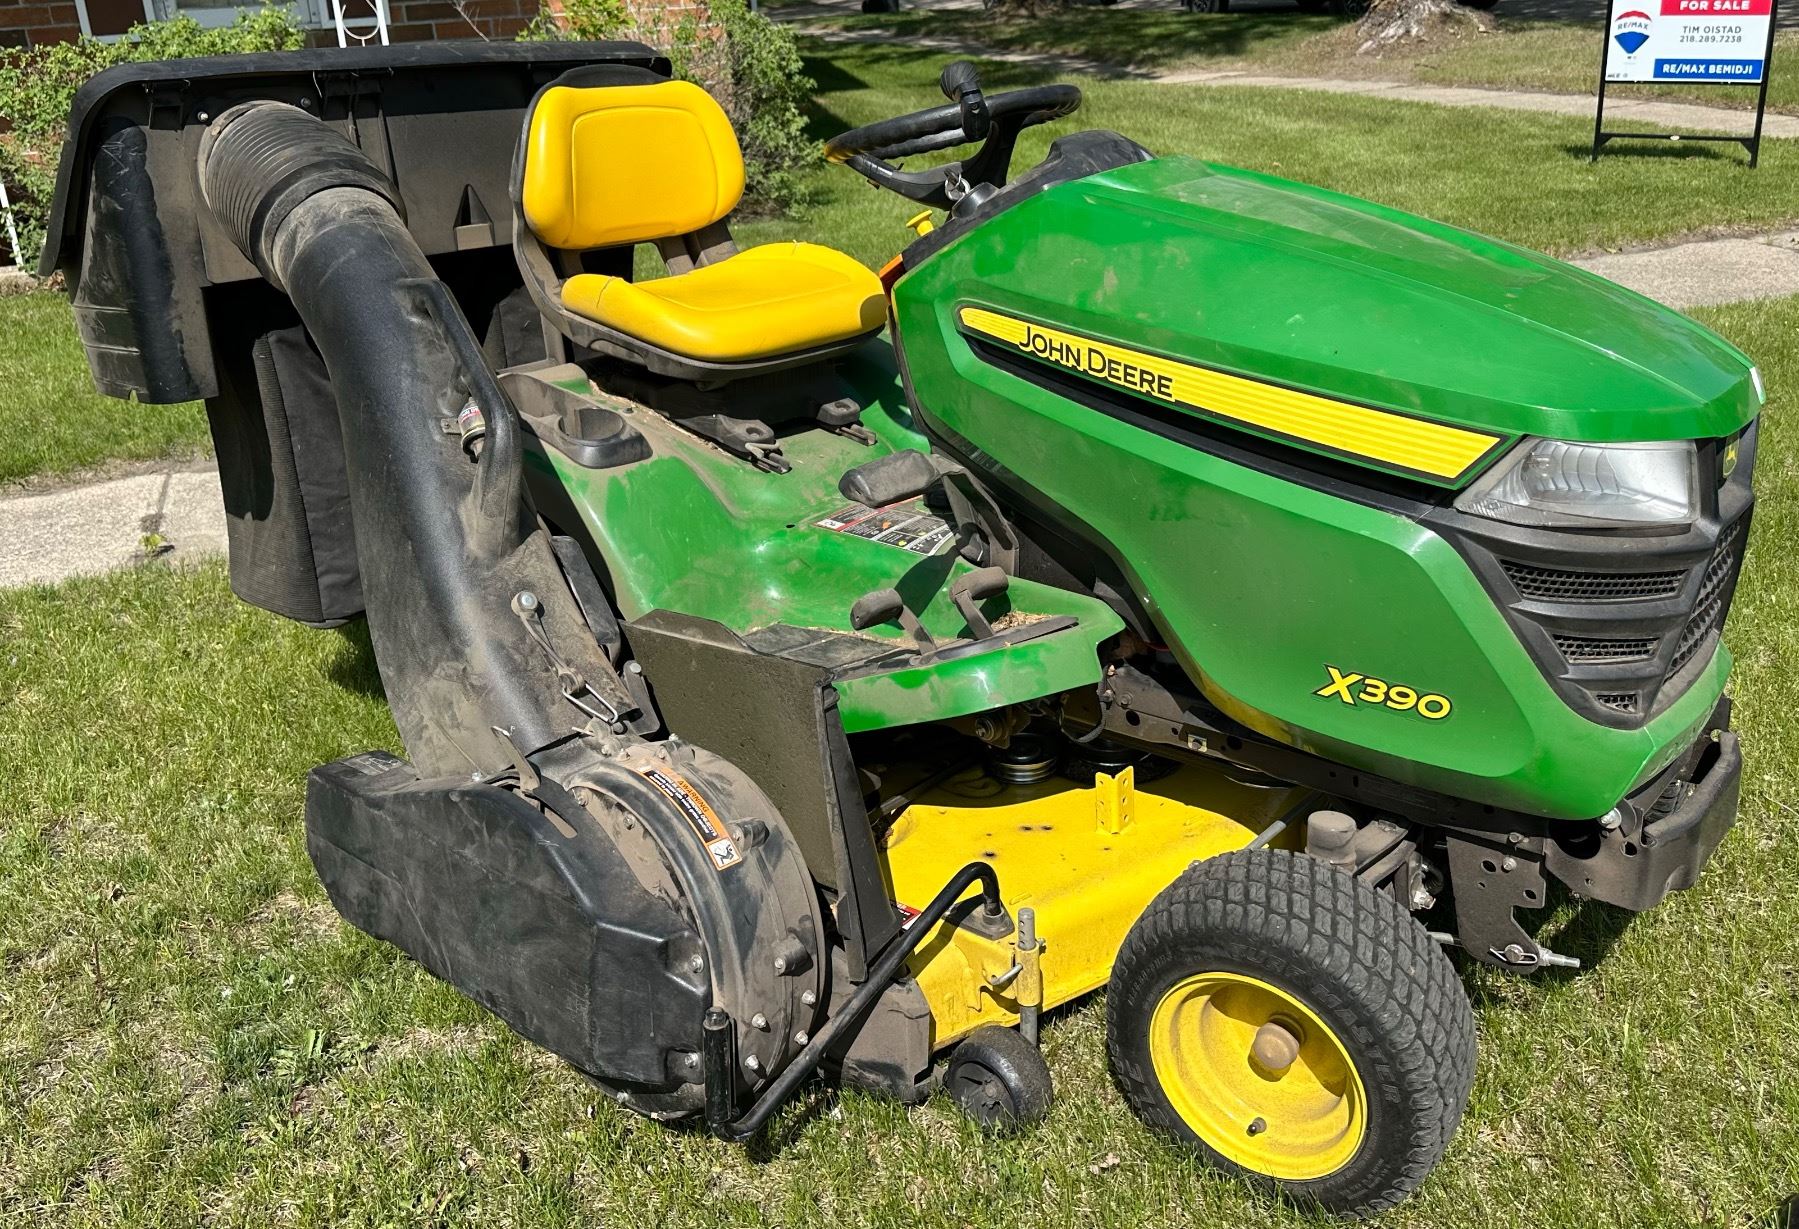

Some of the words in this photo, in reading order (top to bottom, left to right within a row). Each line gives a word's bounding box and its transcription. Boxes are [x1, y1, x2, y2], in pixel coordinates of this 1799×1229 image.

[1680, 0, 1708, 11] FOR
[1713, 0, 1750, 11] SALE
[1617, 22, 1649, 31] RE/MAX
[1682, 26, 1700, 34] TIM
[1703, 26, 1742, 34] OISTAD
[1662, 63, 1706, 74] RE/MAX
[1708, 64, 1753, 75] BEMIDJI
[1018, 325, 1082, 369] JOHN
[1086, 348, 1174, 399] DEERE
[1315, 665, 1453, 720] X390
[682, 783, 710, 813] WARNING
[1230, 942, 1307, 979] TURF
[1311, 983, 1402, 1104] MASTER
